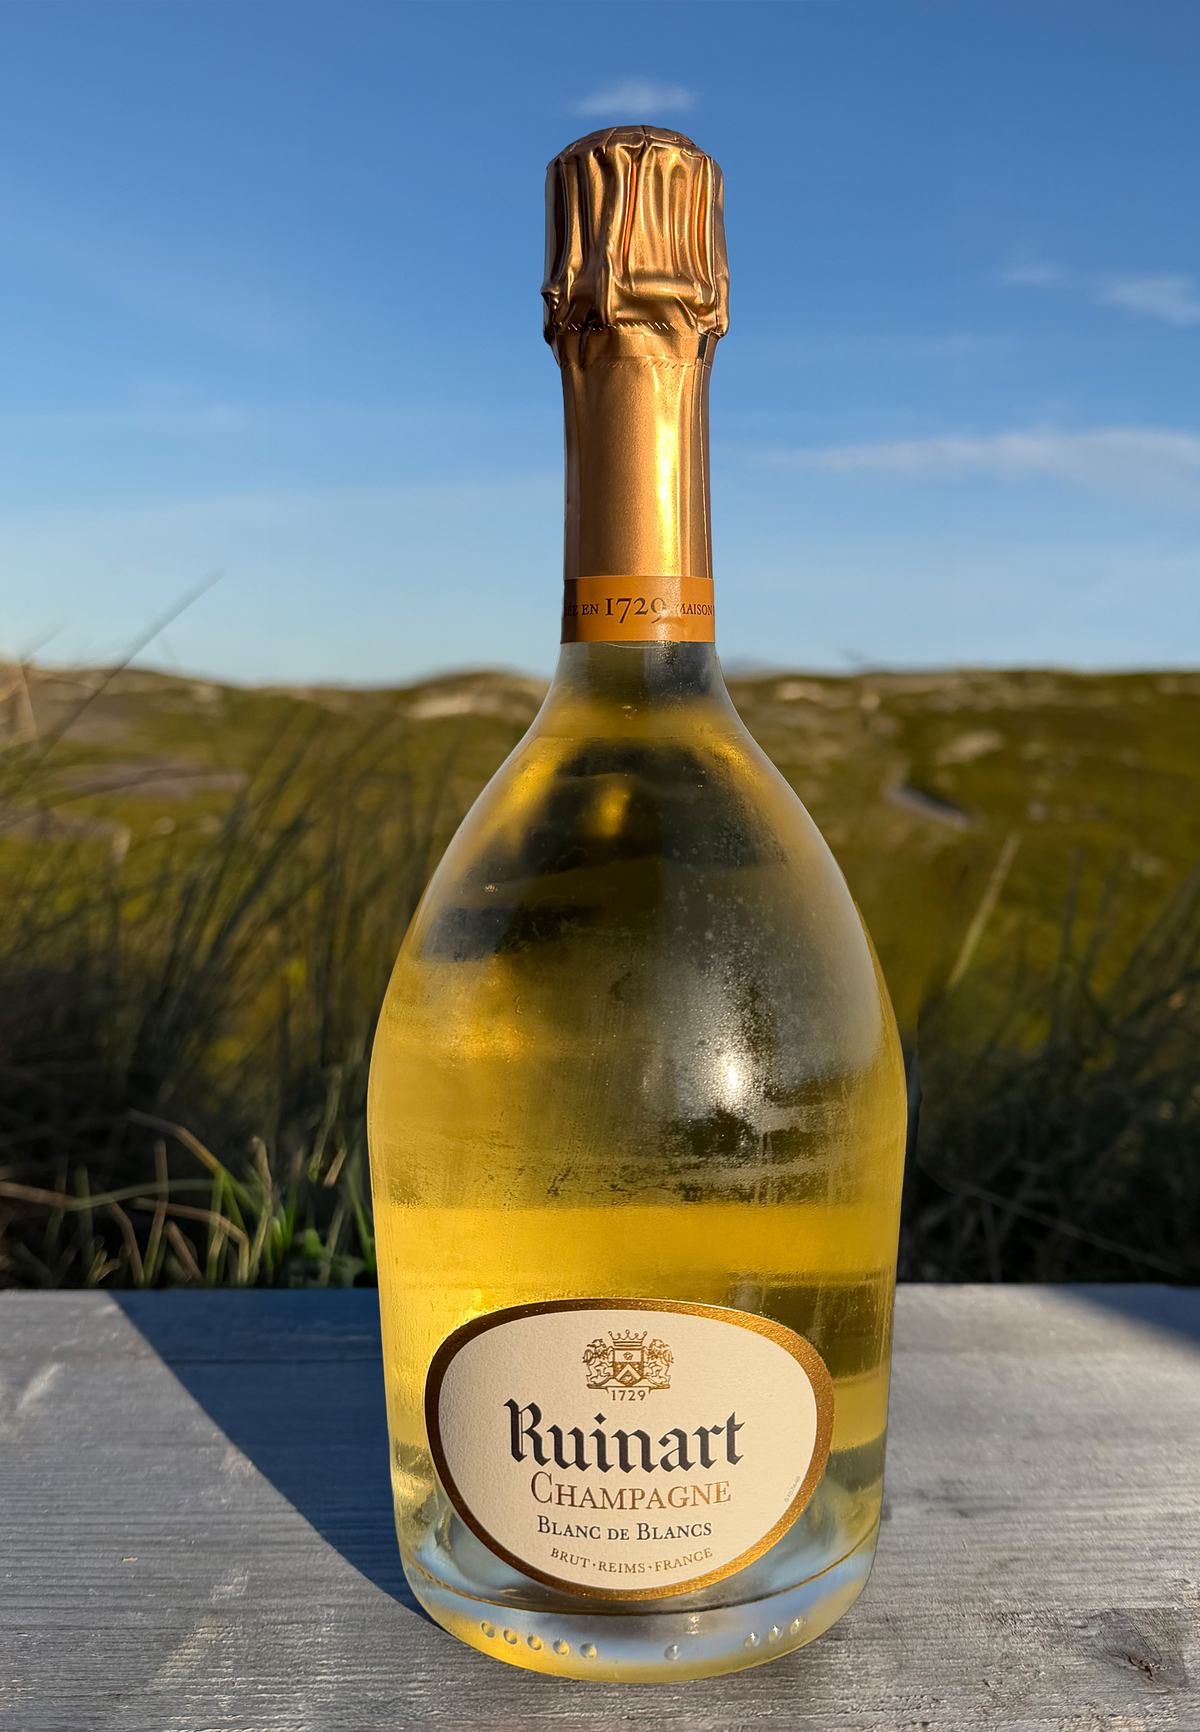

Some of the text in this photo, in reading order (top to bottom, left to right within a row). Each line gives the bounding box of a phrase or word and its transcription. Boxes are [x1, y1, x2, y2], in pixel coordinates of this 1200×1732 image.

[581, 604, 599, 616] EN
[605, 597, 667, 624] 1729
[611, 1389, 646, 1401] 1729
[503, 1398, 746, 1473] Ruinart
[530, 1471, 731, 1510] CHAMPAGNE
[537, 1514, 712, 1541] BLANC DE BLANCS
[550, 1547, 713, 1574] BRUT REIMS FRANCE
